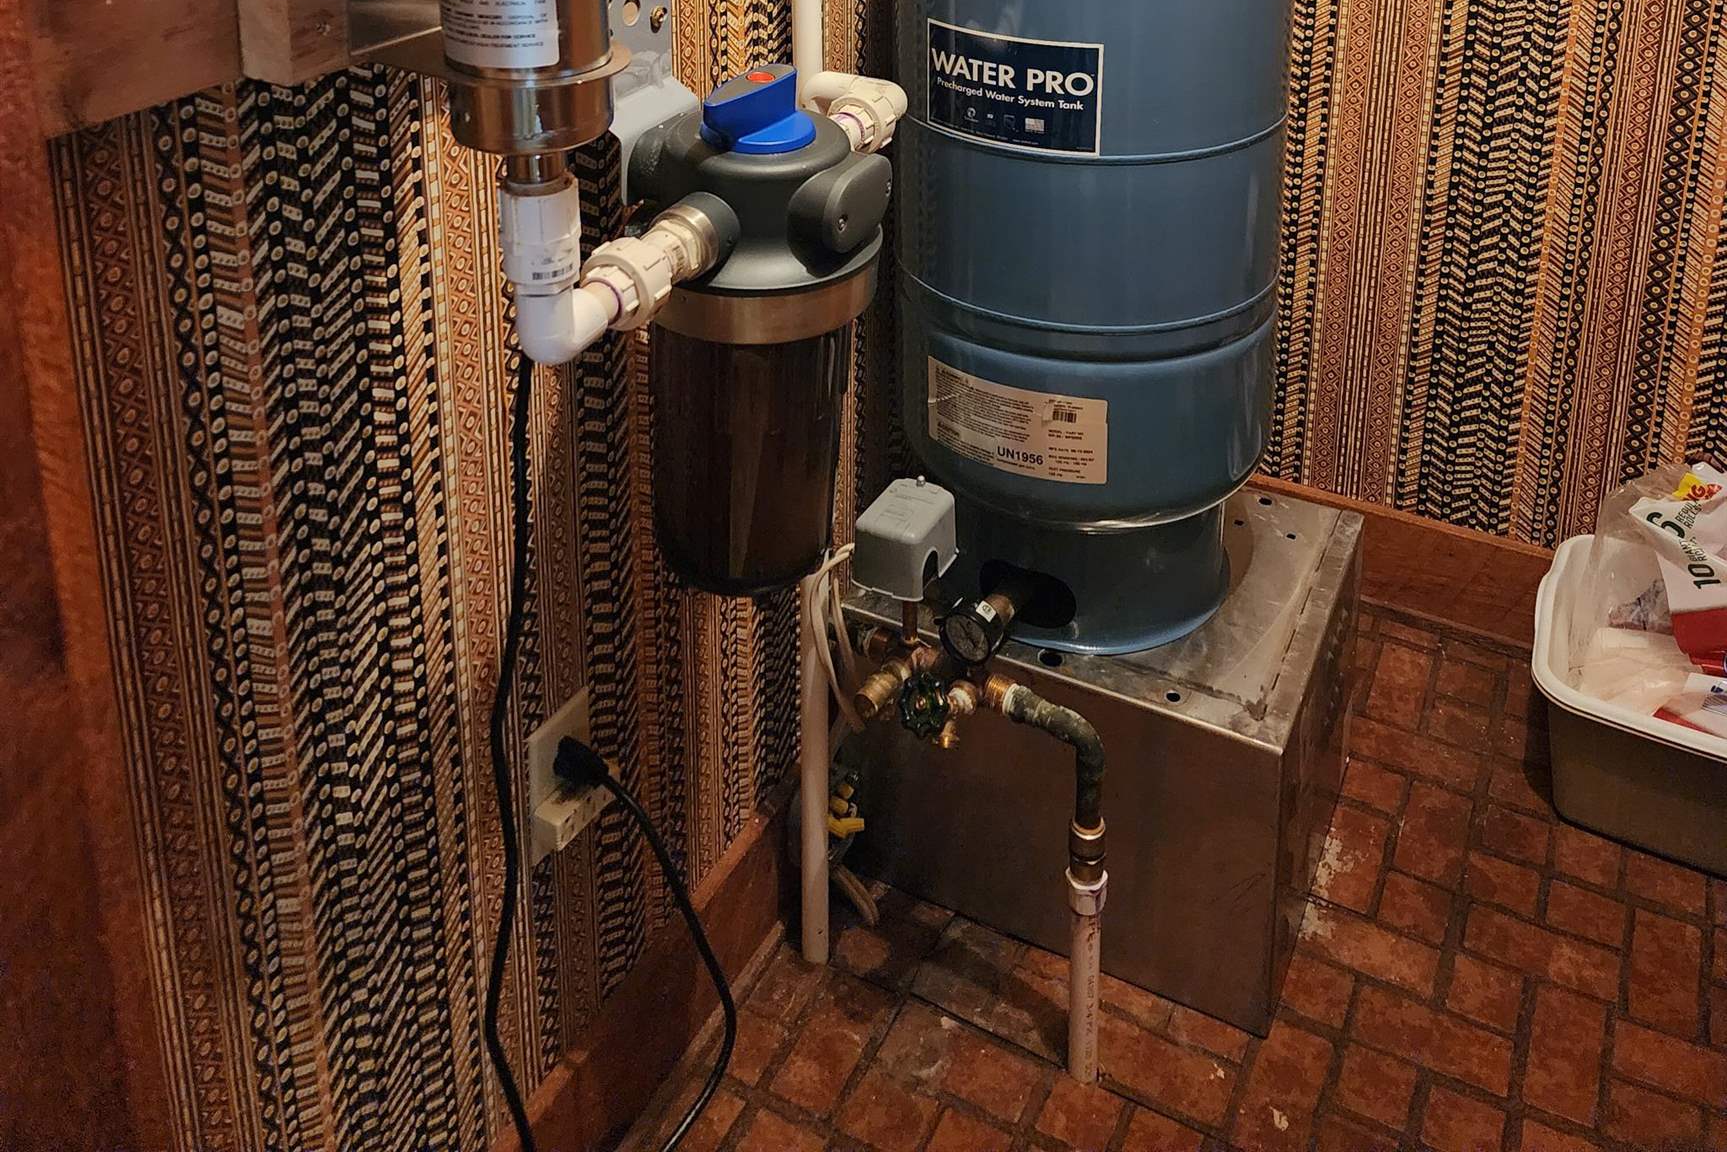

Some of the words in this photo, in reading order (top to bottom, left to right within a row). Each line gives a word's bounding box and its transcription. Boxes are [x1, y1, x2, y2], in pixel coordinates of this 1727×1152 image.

[931, 47, 1017, 90] WATER
[1026, 67, 1095, 97] PRO
[936, 76, 983, 98] Precharged
[985, 88, 1015, 103] Water
[1018, 95, 1055, 109] System
[1058, 98, 1084, 111] Tank
[996, 445, 1044, 466] UN1956
[1687, 563, 1721, 590] 10
